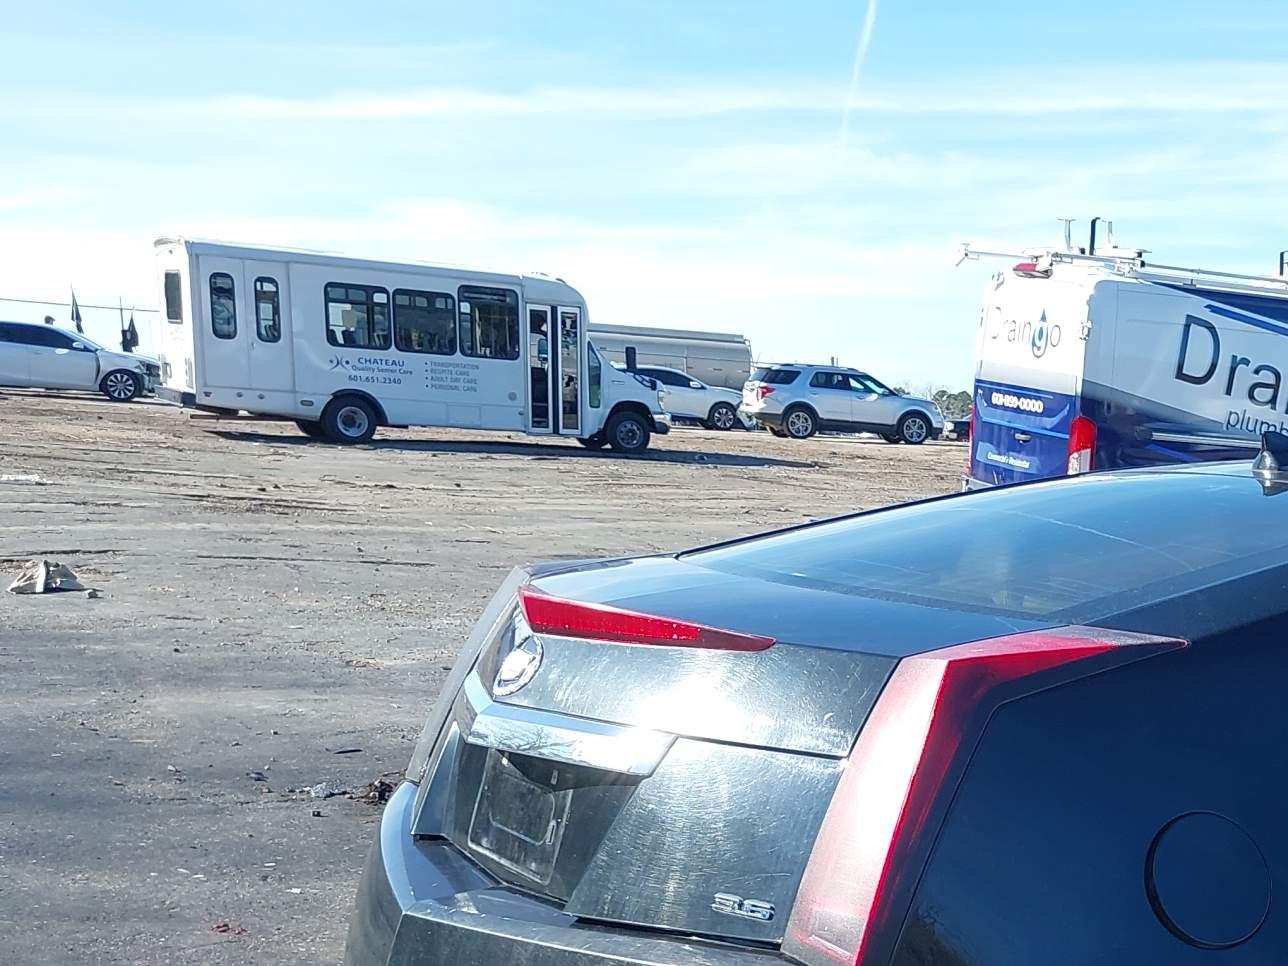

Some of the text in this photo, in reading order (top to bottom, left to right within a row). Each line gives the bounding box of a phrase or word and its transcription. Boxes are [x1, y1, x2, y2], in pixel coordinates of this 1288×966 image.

[358, 357, 404, 367] CHATEAU
[351, 364, 376, 374] Quality
[398, 367, 413, 375] Care
[348, 375, 402, 384] 601.651.2340
